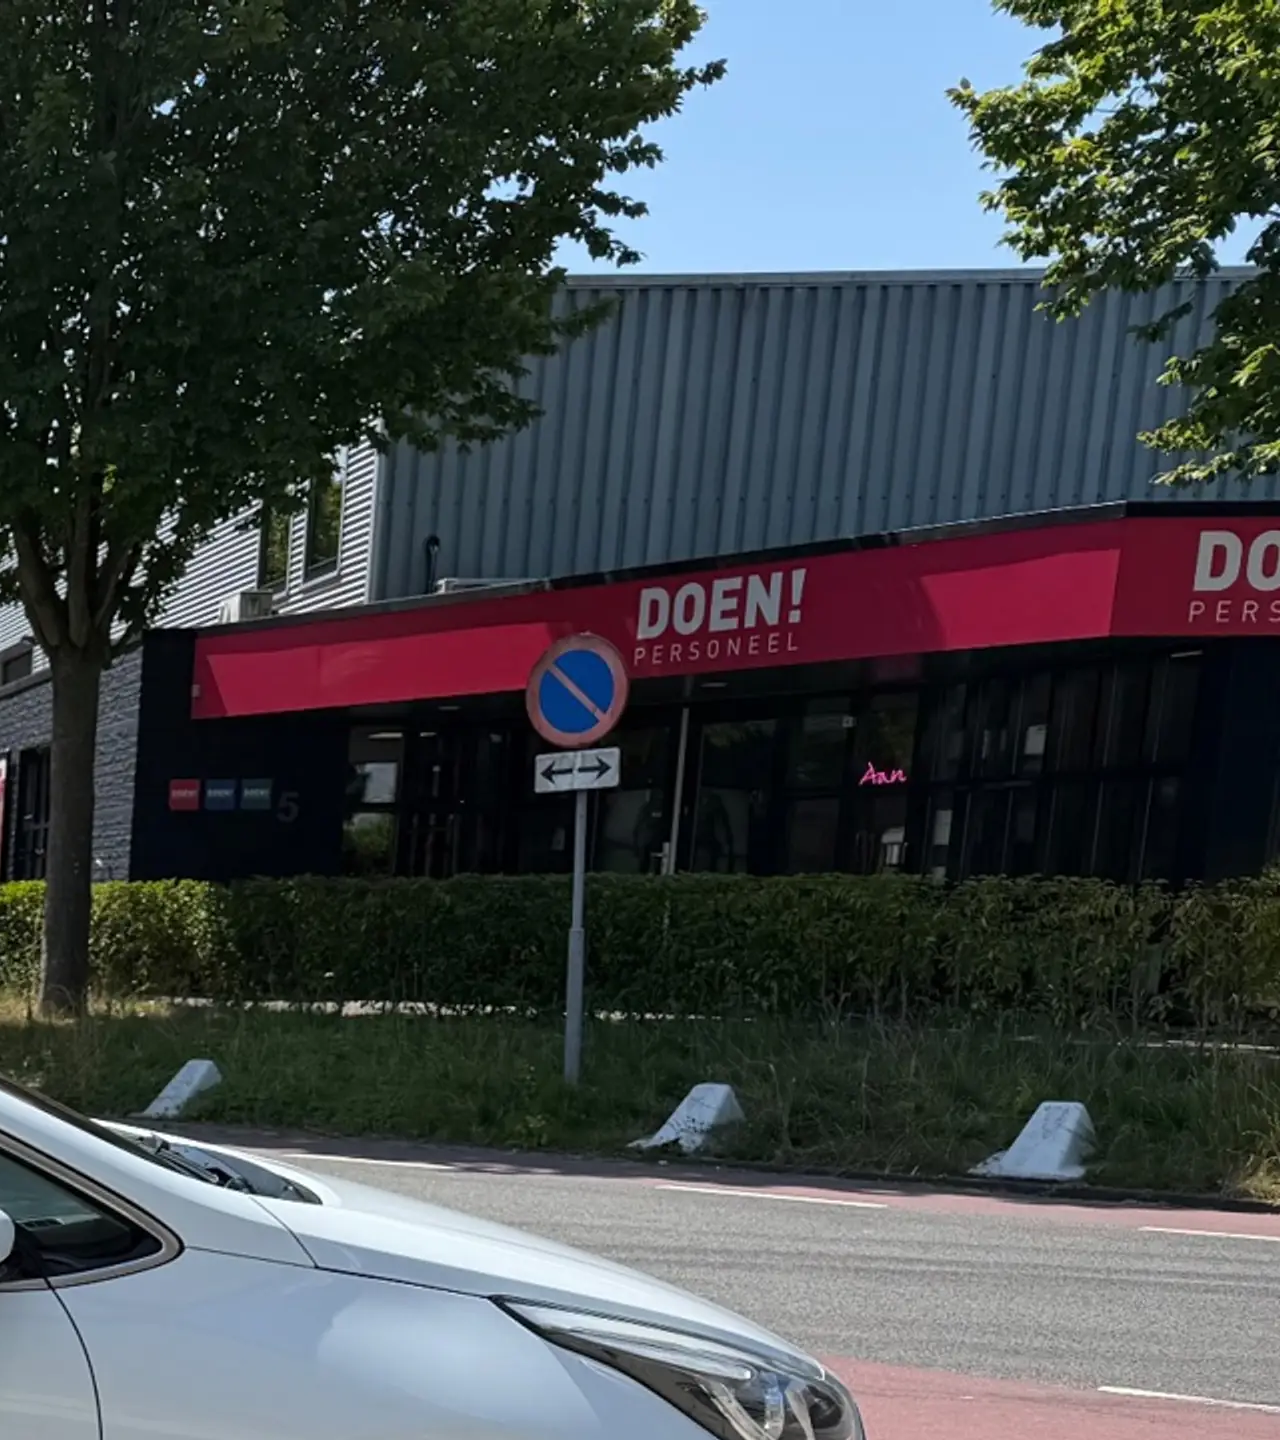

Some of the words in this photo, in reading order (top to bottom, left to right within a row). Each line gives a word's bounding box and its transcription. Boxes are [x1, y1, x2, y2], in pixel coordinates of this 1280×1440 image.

[636, 568, 806, 640] DOEN!
[633, 632, 798, 667] PERSONEEL
[276, 791, 300, 822] 5
